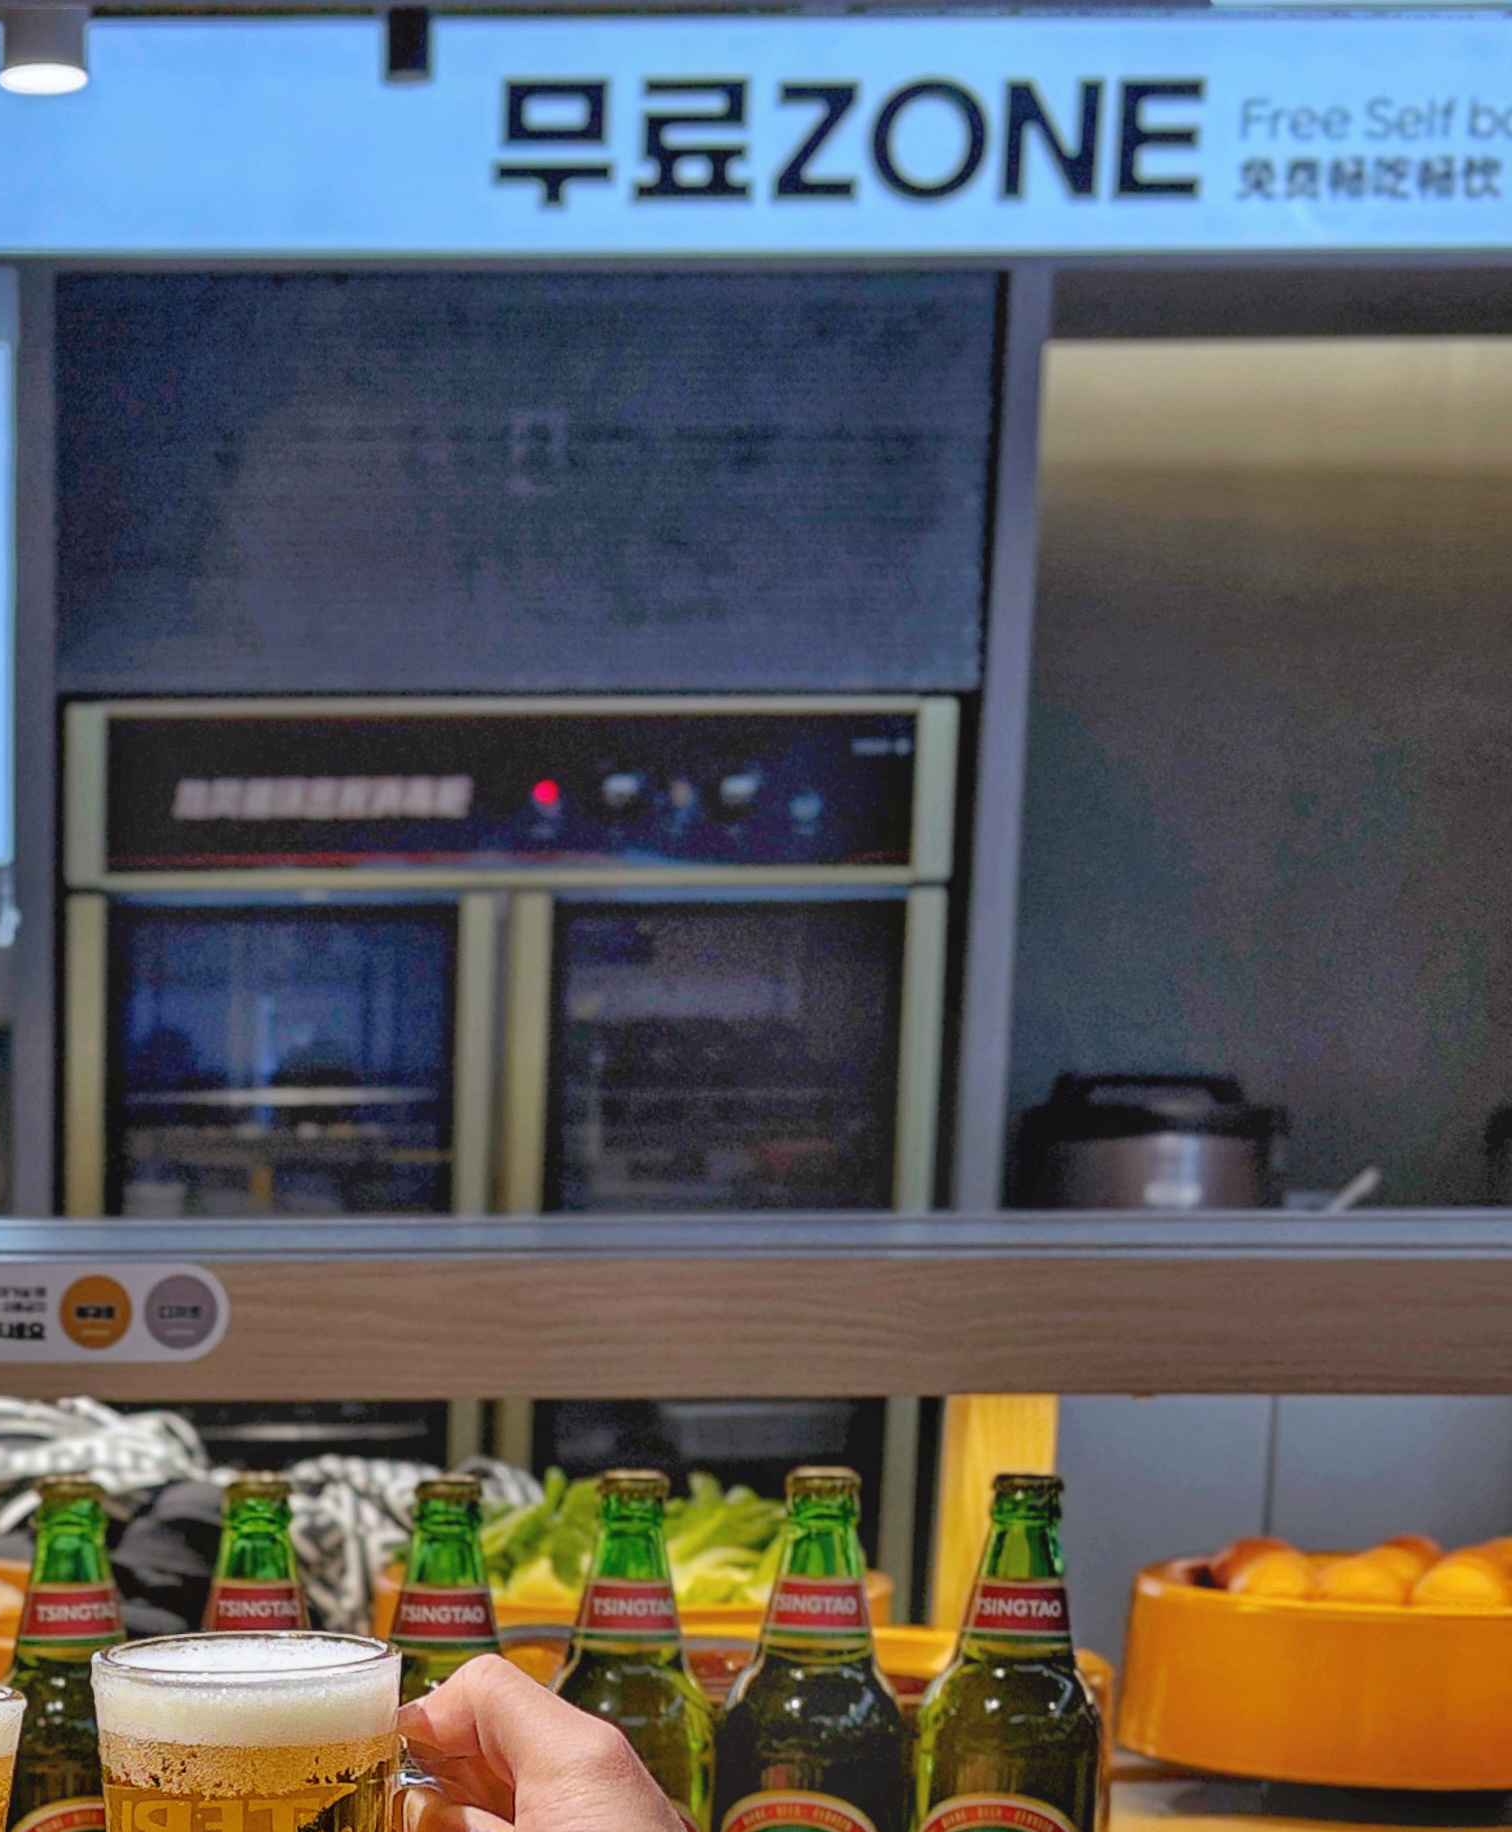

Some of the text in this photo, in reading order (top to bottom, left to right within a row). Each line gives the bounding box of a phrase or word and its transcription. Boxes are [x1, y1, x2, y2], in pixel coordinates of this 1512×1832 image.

[1240, 97, 1351, 140] Free
[1364, 97, 1459, 140] Self
[491, 74, 1205, 207] 무료ZONE
[36, 1602, 116, 1622] TSINGTA
[400, 1604, 486, 1623] TSINGTAO
[976, 1597, 1062, 1618] TSINGTAO
